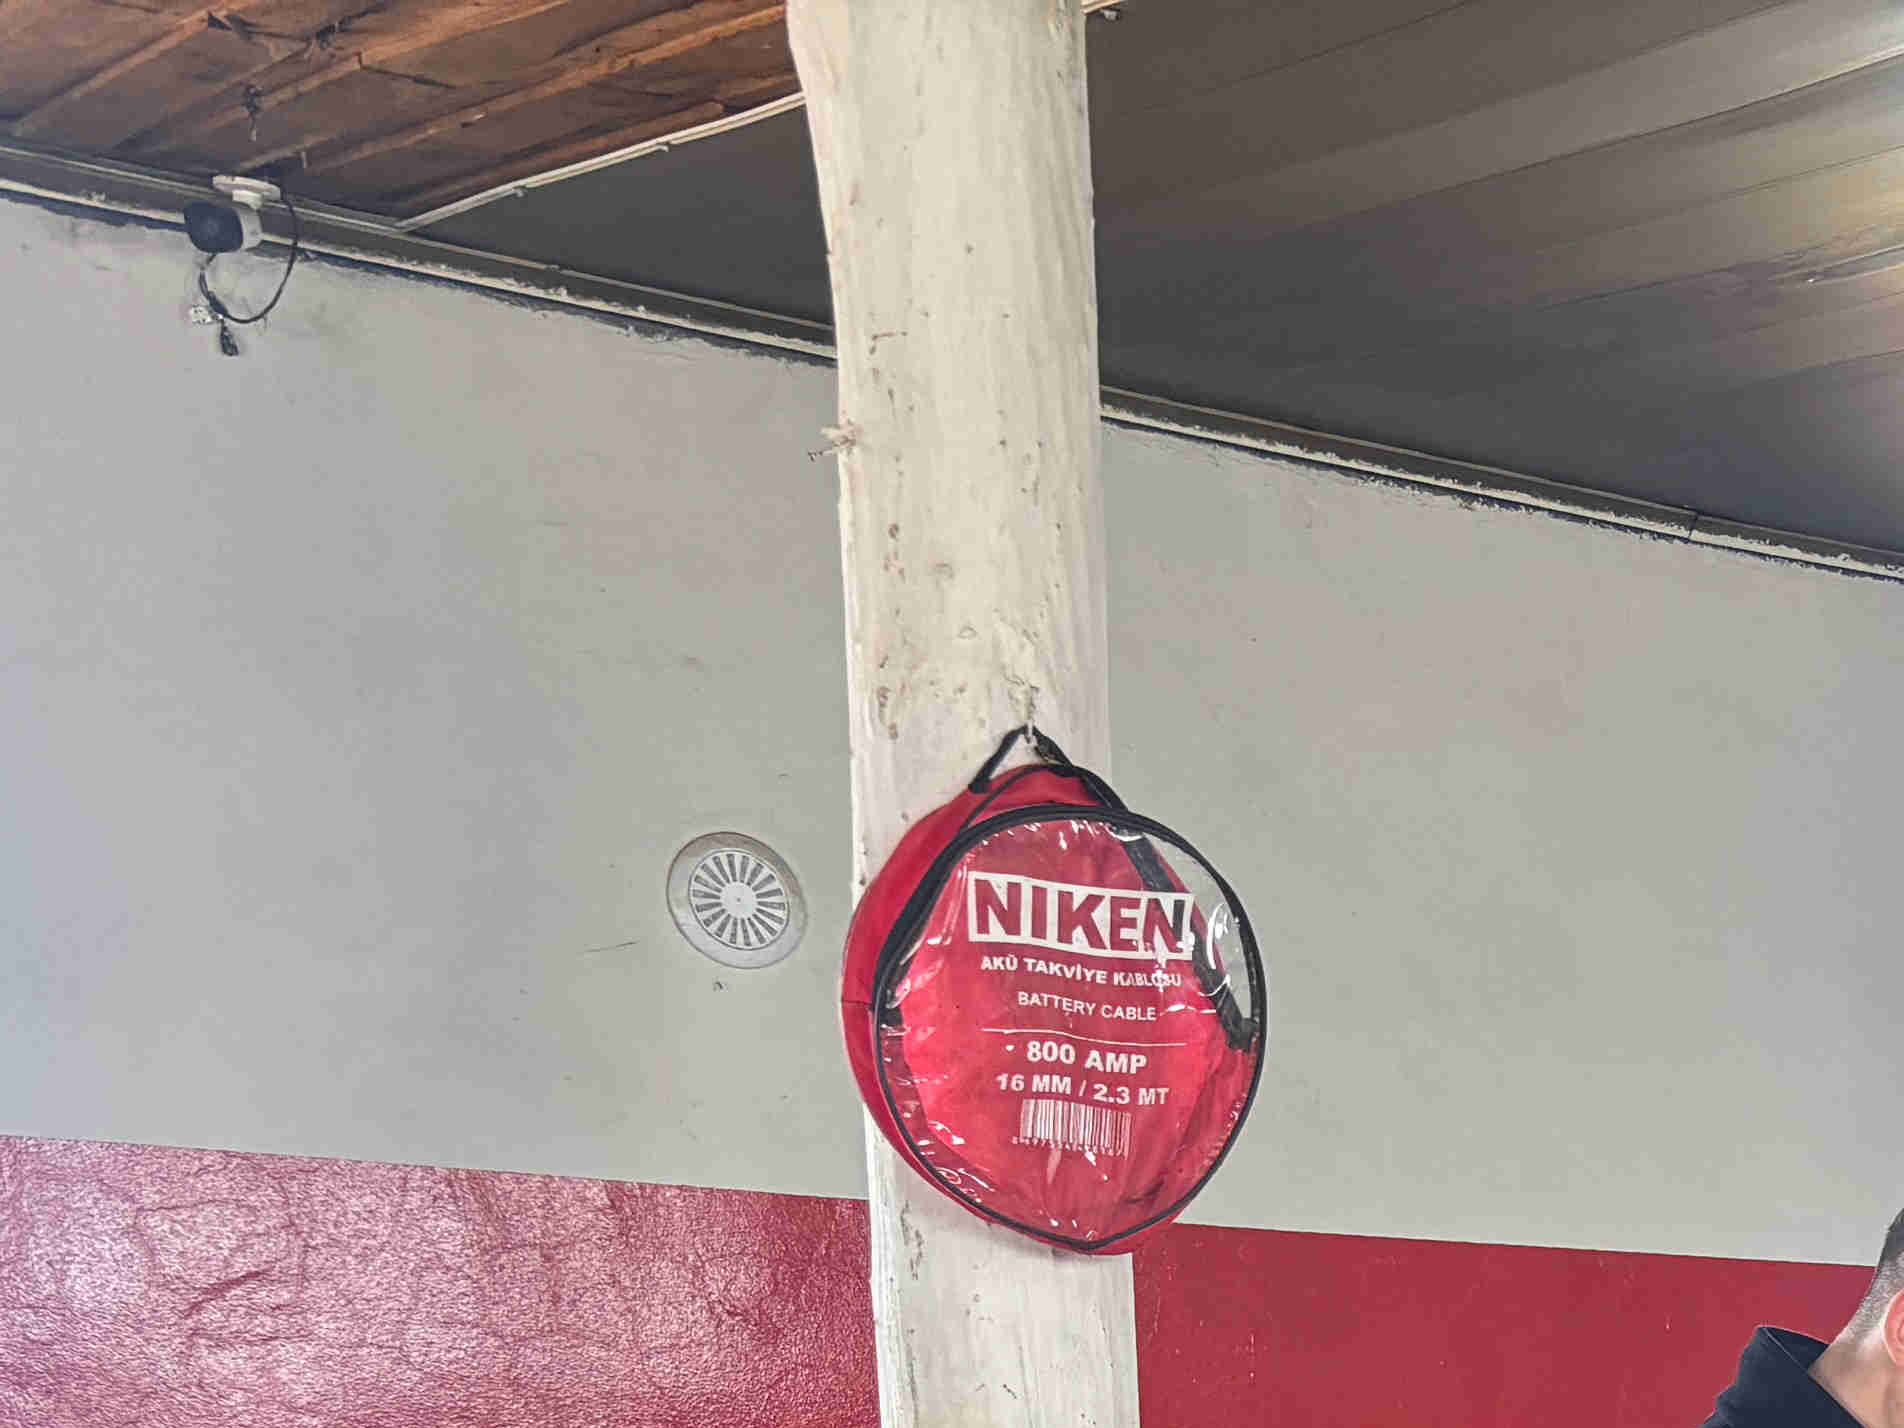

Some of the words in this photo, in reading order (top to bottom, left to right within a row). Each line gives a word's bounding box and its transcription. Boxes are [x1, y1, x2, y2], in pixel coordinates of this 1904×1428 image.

[974, 878, 1187, 953] NIKEN
[1023, 957, 1107, 985] TAKVİYE
[1017, 991, 1096, 1017] BATTERY
[1101, 1004, 1157, 1021] CABLE
[1026, 1040, 1076, 1065] 800
[1084, 1050, 1147, 1074] AMP
[996, 1072, 1025, 1092] 16
[1031, 1074, 1072, 1095] MM
[1093, 1083, 1130, 1105] 2.3
[1137, 1087, 1169, 1105] MT
